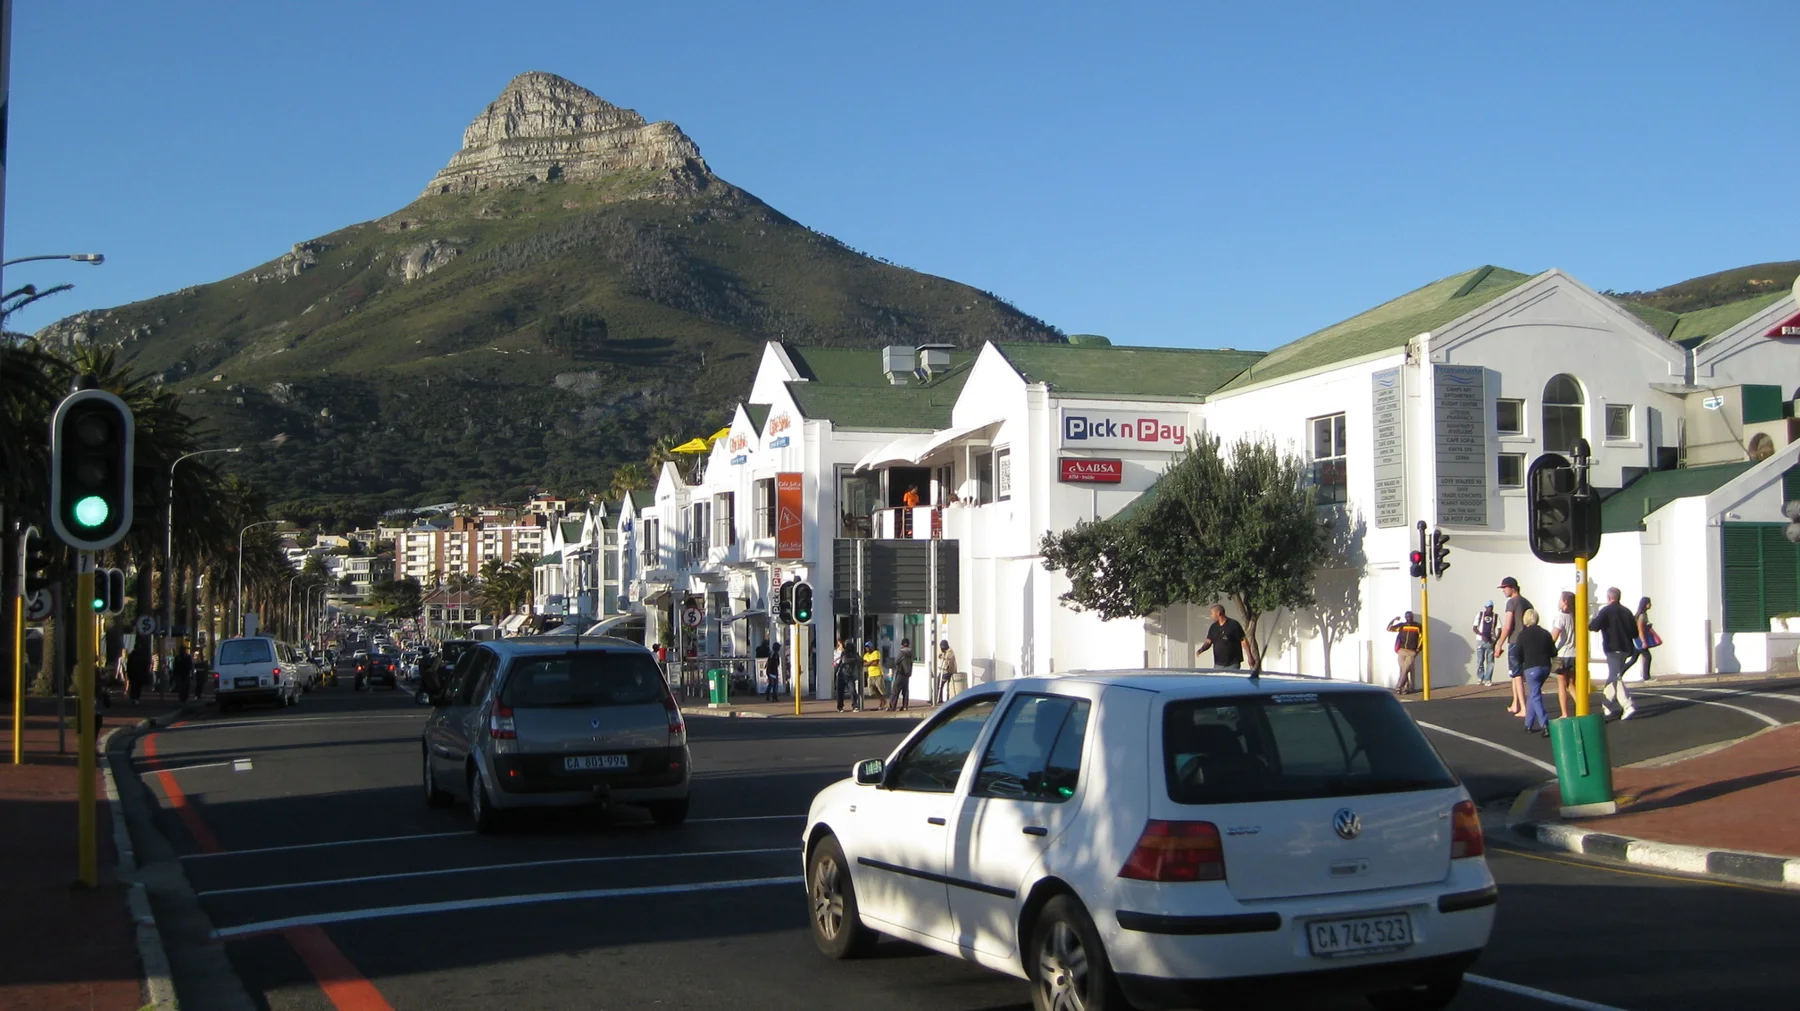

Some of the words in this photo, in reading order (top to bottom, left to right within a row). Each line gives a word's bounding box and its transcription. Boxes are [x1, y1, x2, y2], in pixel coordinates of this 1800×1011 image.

[1065, 416, 1117, 440] Pick
[1121, 423, 1133, 438] n
[1137, 418, 1184, 445] Pay
[1085, 463, 1115, 472] ABSA
[773, 568, 781, 586] Pay
[567, 758, 580, 769] CA
[1316, 925, 1340, 948] CA
